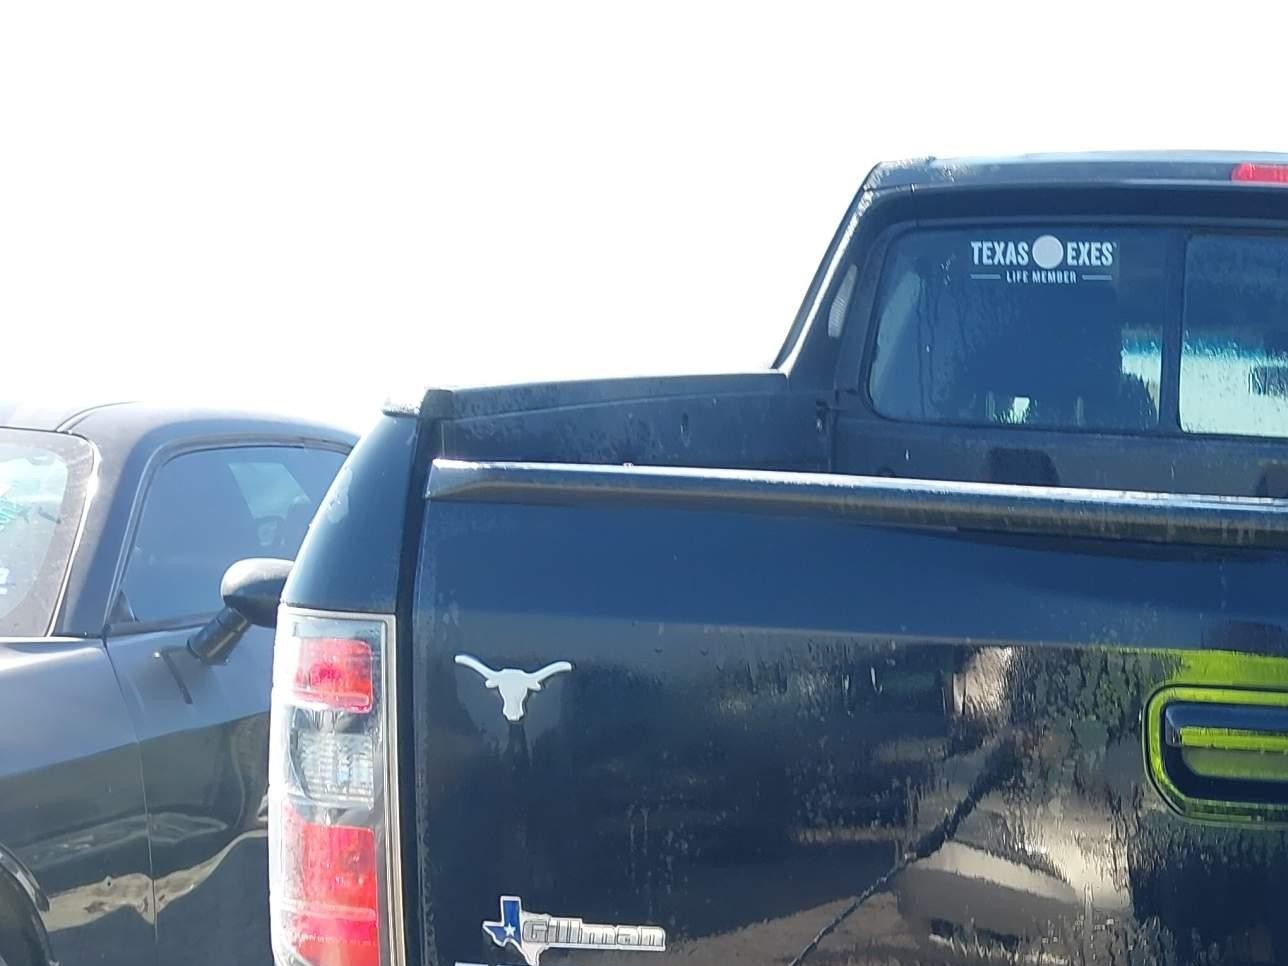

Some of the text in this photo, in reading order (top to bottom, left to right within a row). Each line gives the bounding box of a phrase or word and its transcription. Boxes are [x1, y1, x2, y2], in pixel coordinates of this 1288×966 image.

[970, 241, 1114, 267] TEXAS EXES
[1006, 270, 1077, 285] LIFE MEMBER
[522, 916, 665, 949] Gillman
